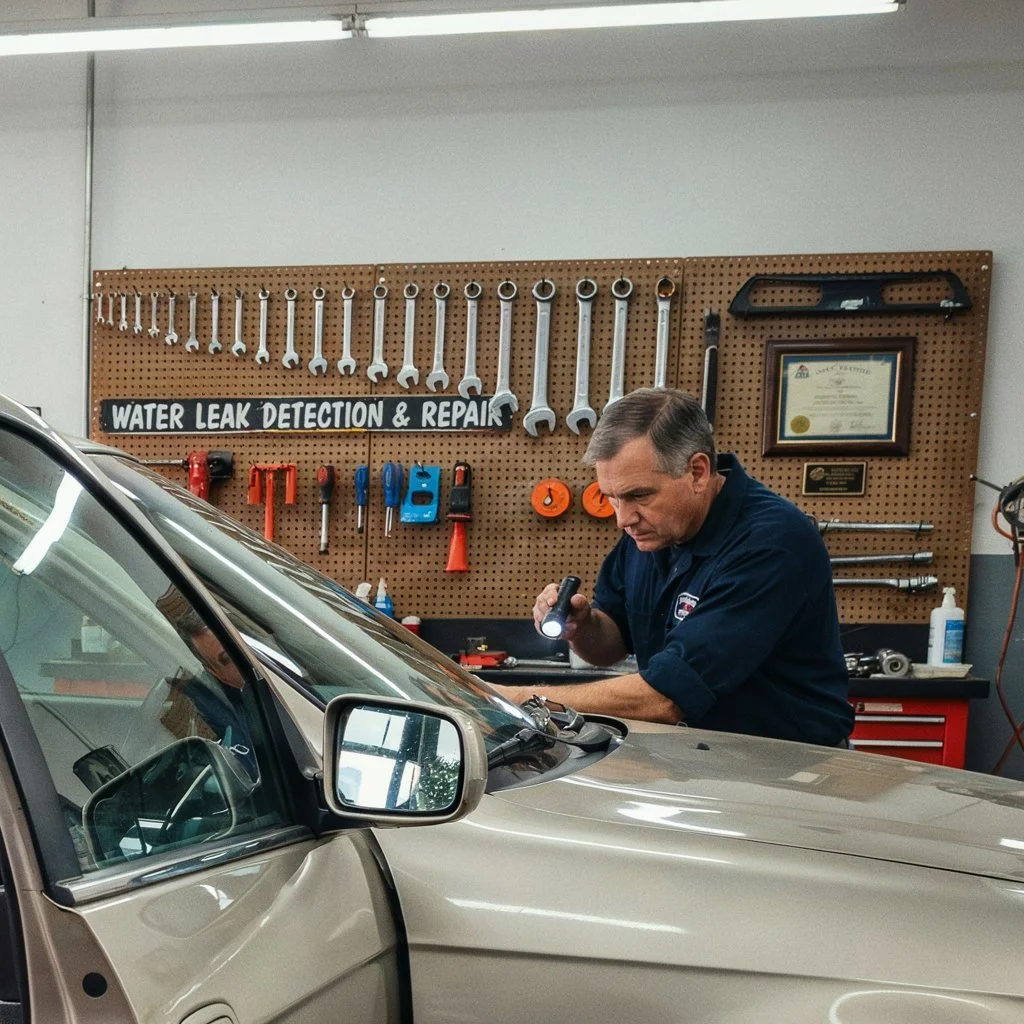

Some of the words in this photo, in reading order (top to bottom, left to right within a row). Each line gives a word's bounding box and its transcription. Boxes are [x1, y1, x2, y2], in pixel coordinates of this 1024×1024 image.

[112, 402, 184, 430] WATER
[196, 402, 251, 429] LEAK
[263, 401, 384, 429] DETECTION
[392, 401, 411, 428] &
[421, 400, 503, 428] REPAIR
